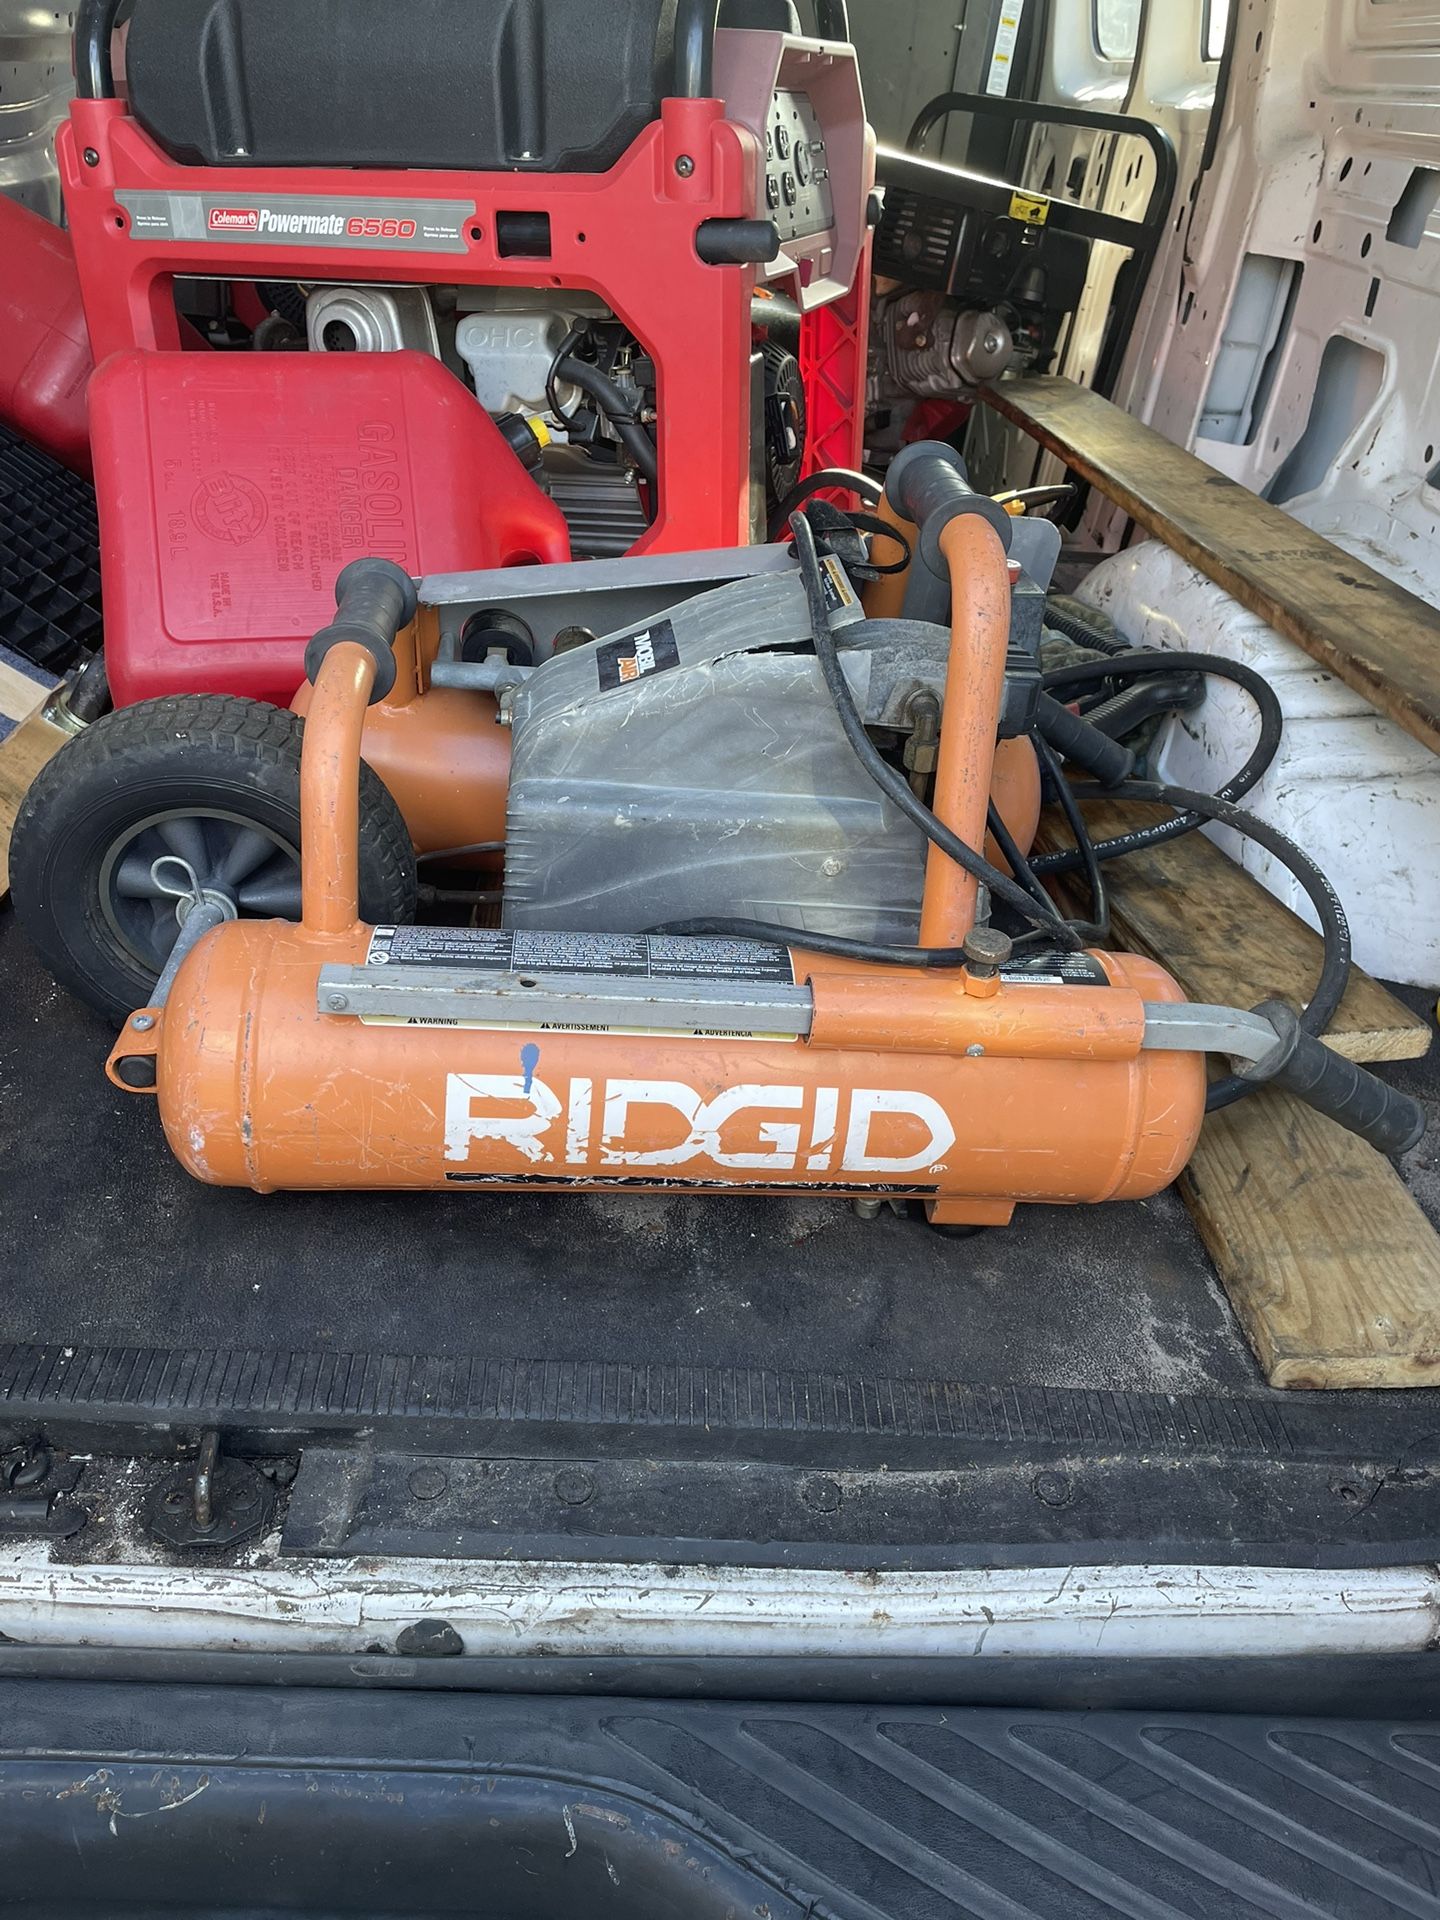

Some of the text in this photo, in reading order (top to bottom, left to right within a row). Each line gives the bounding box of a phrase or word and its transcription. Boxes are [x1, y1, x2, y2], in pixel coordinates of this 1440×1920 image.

[211, 208, 417, 239] Coleman Powermate 6560
[464, 326, 535, 348] OHC
[336, 467, 365, 549] DANGER
[356, 420, 408, 573] GASOLIN
[419, 1017, 459, 1026] WARNING
[551, 1022, 610, 1032] AVERTISSEMENT
[704, 1029, 753, 1037] ADVERTENCIA
[444, 1072, 957, 1173] RIDGID
